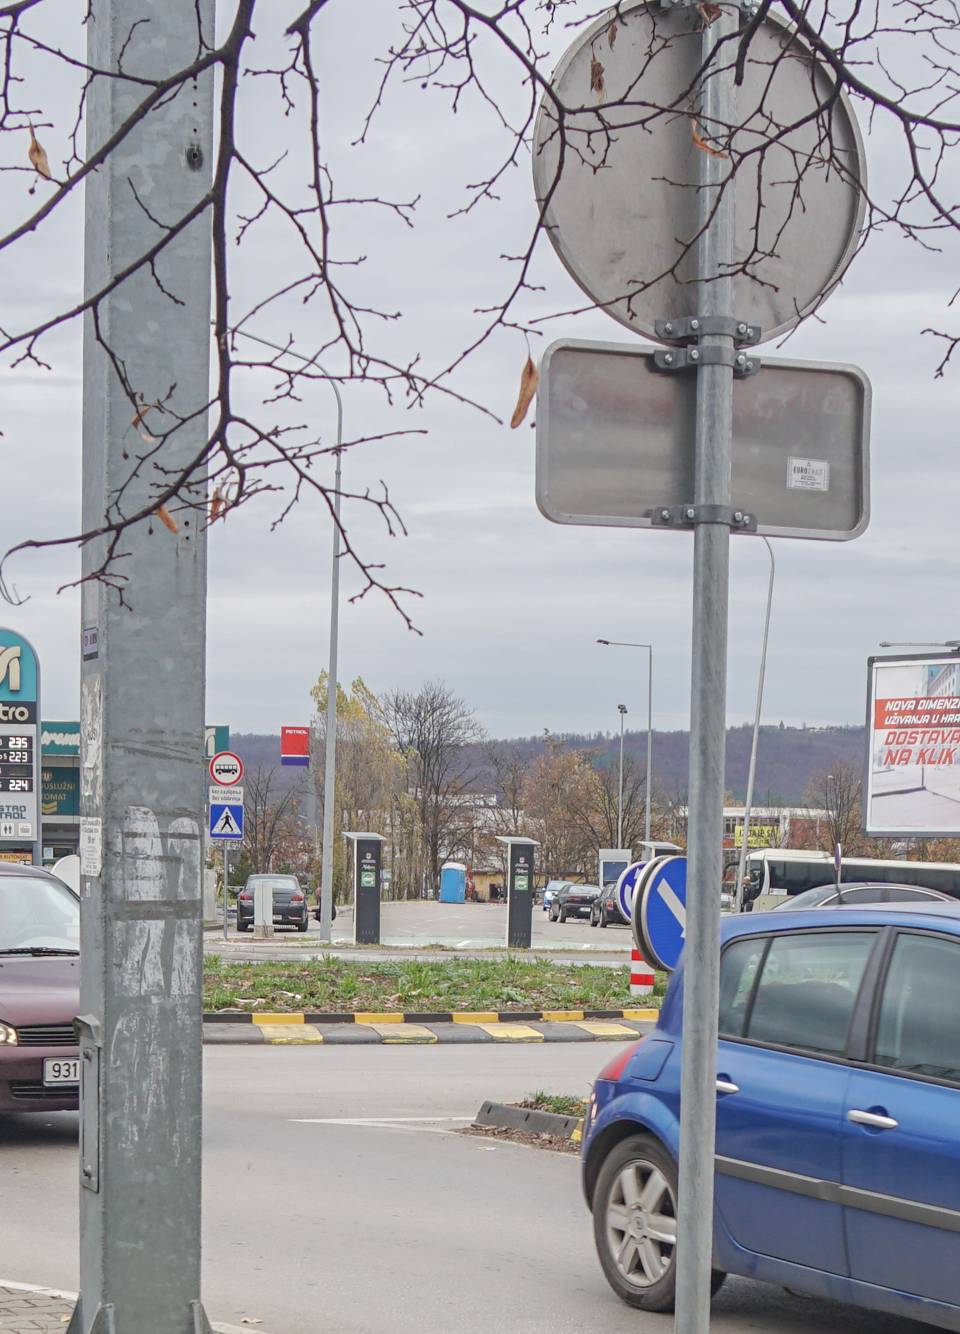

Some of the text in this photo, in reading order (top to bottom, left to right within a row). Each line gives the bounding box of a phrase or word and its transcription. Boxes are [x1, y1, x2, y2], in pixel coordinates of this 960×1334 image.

[885, 700, 915, 712] NOVA
[884, 712, 929, 725] UŽIVANJA
[931, 714, 939, 723] U
[883, 748, 957, 766] NA KLIK
[52, 1062, 77, 1078] 931
